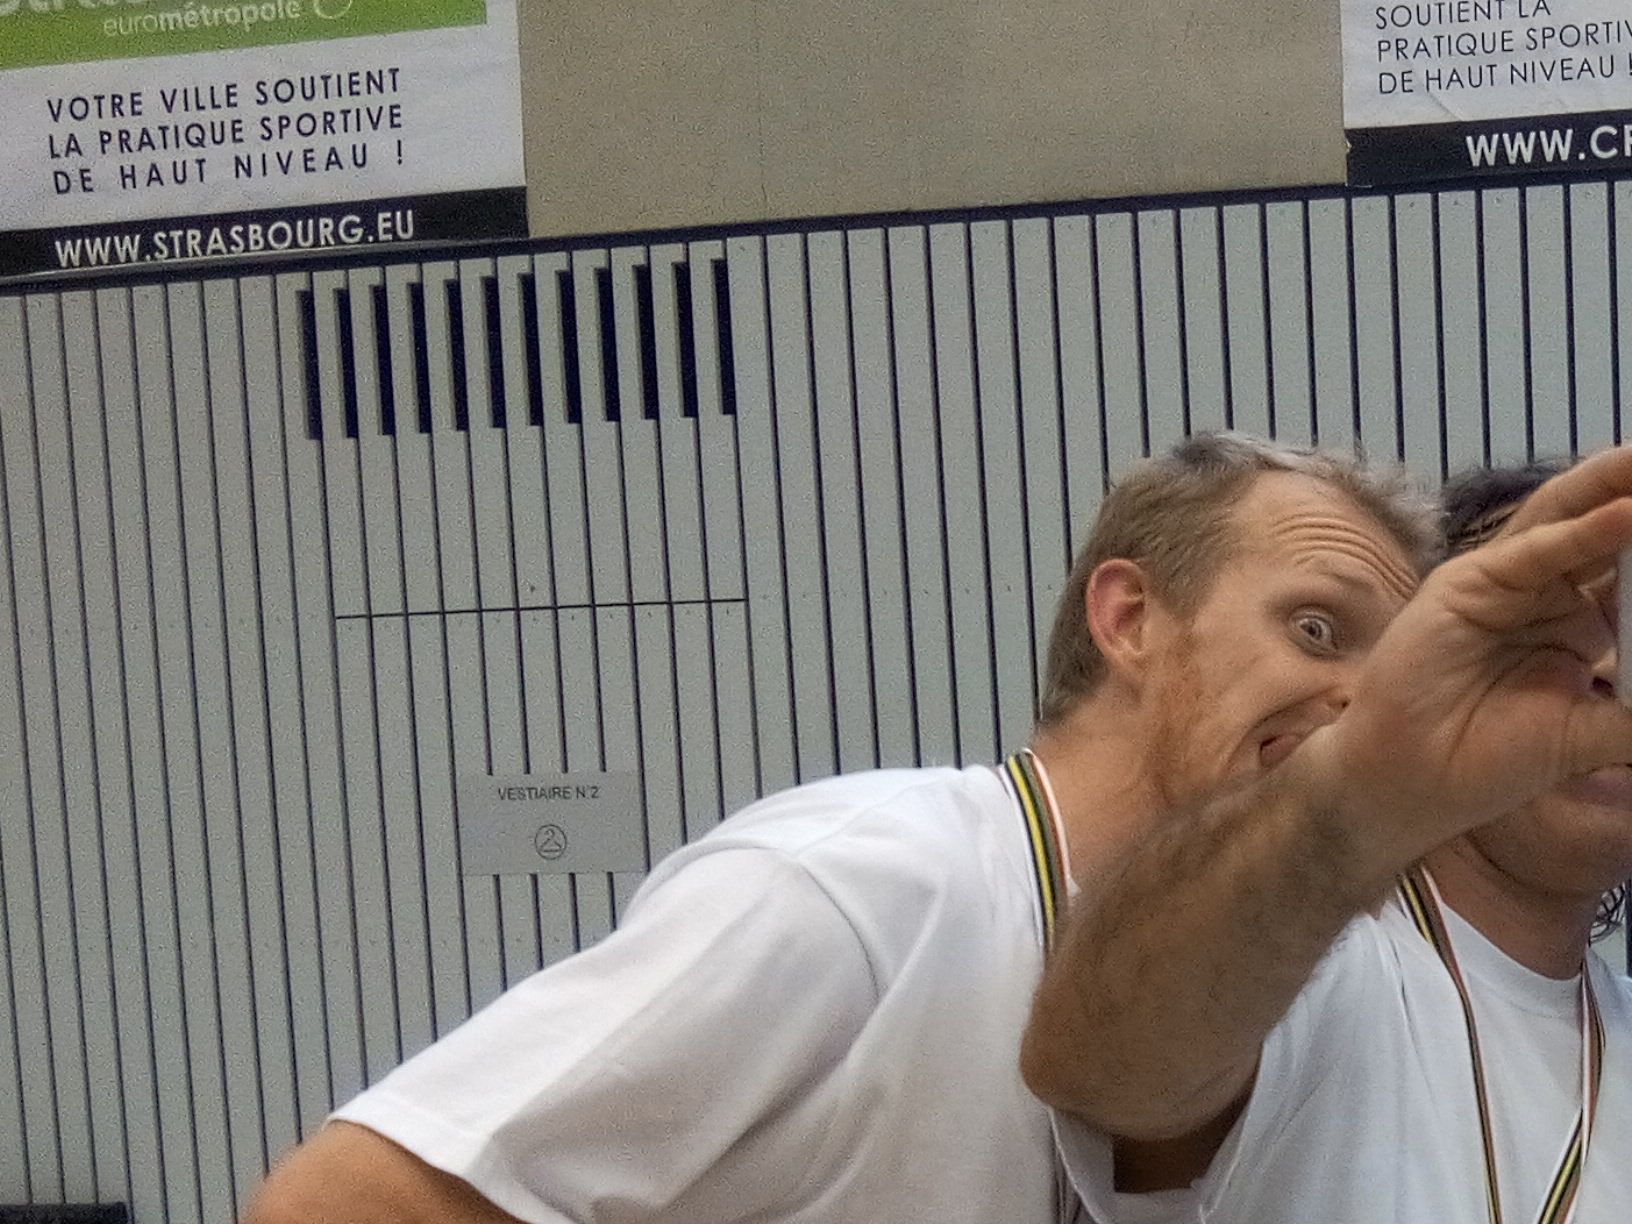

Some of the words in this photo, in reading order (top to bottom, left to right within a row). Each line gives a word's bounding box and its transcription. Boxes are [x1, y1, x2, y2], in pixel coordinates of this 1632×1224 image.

[1376, 0, 1504, 29] SOUTIENT
[1518, 0, 1551, 19] LA
[1378, 30, 1514, 62] PRATIQUE
[47, 92, 143, 123] VOTRE
[160, 84, 239, 114] VILLE
[256, 68, 401, 105] SOUTIENT
[1379, 70, 1414, 95] DE
[1426, 64, 1498, 93] HAUT
[1510, 54, 1616, 85] NIVEAU
[48, 132, 83, 160] LA
[100, 119, 244, 156] PRATIQUE
[260, 104, 402, 141] SPORTIVE
[53, 168, 95, 195] DE
[121, 158, 207, 190] HAUT
[235, 143, 368, 180] NIVEAU
[55, 210, 415, 268] WWW.STRASBOURG.EU
[498, 785, 573, 800] VESTIAIRE
